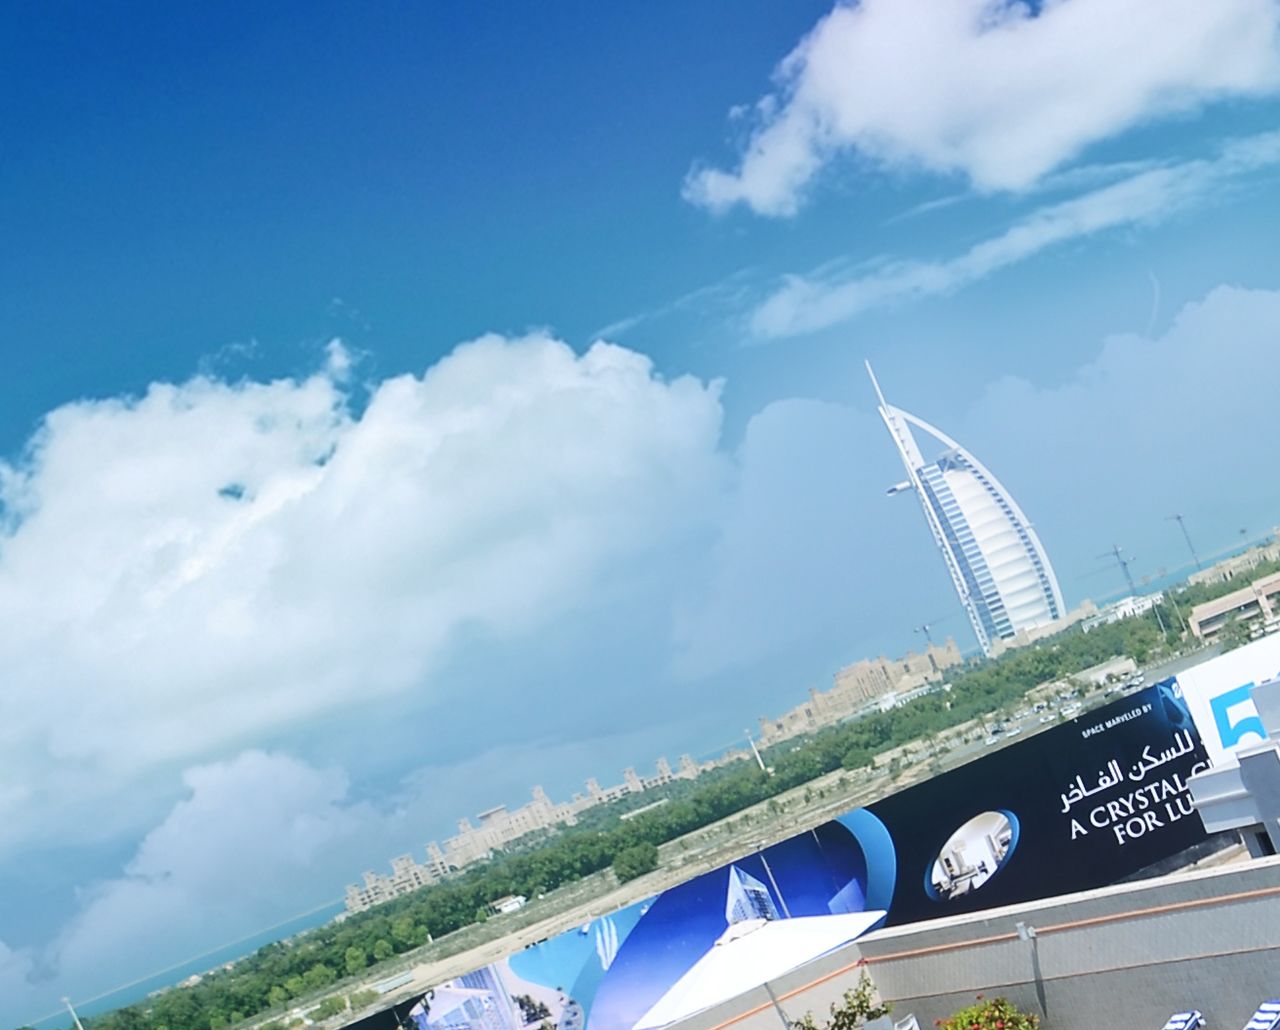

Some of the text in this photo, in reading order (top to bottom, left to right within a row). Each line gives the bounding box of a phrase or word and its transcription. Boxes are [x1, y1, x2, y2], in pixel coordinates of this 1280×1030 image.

[1081, 703, 1153, 739] SPACE MARVELED BY
[1061, 728, 1195, 813] للسكن الفاخر
[1071, 818, 1089, 840] A
[1089, 773, 1189, 828] CRYSTAL
[1113, 811, 1165, 845] FOR
